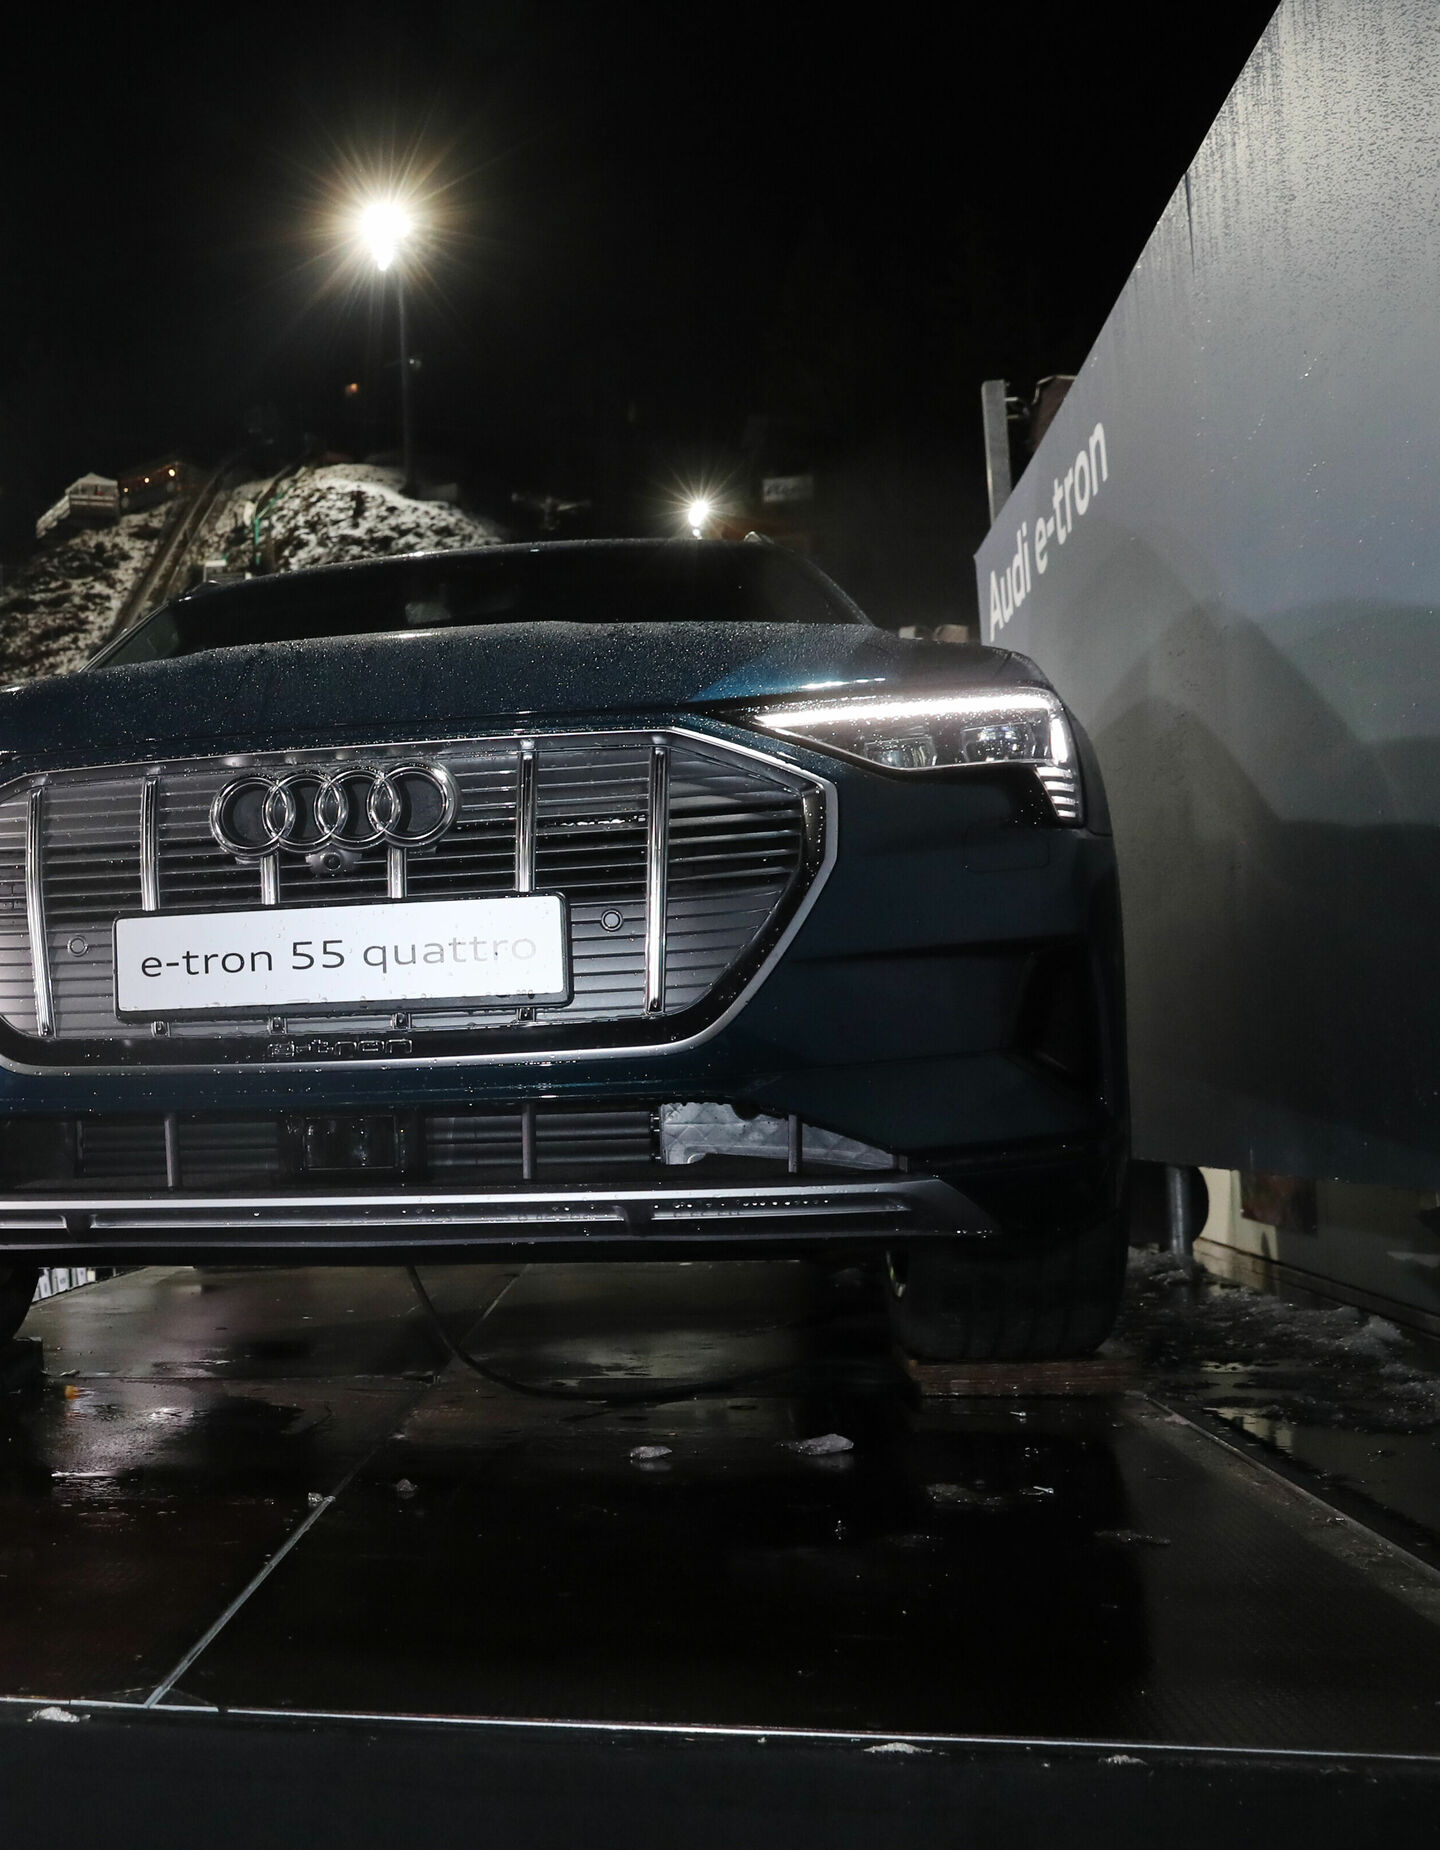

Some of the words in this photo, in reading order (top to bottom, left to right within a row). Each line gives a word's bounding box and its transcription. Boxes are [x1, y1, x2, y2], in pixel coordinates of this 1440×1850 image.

[989, 521, 1031, 643] Audi
[1035, 422, 1108, 575] e-tron
[141, 950, 273, 977] e-tron
[292, 940, 345, 970] 55
[363, 936, 537, 974] quattro
[266, 1038, 413, 1057] e-tron
